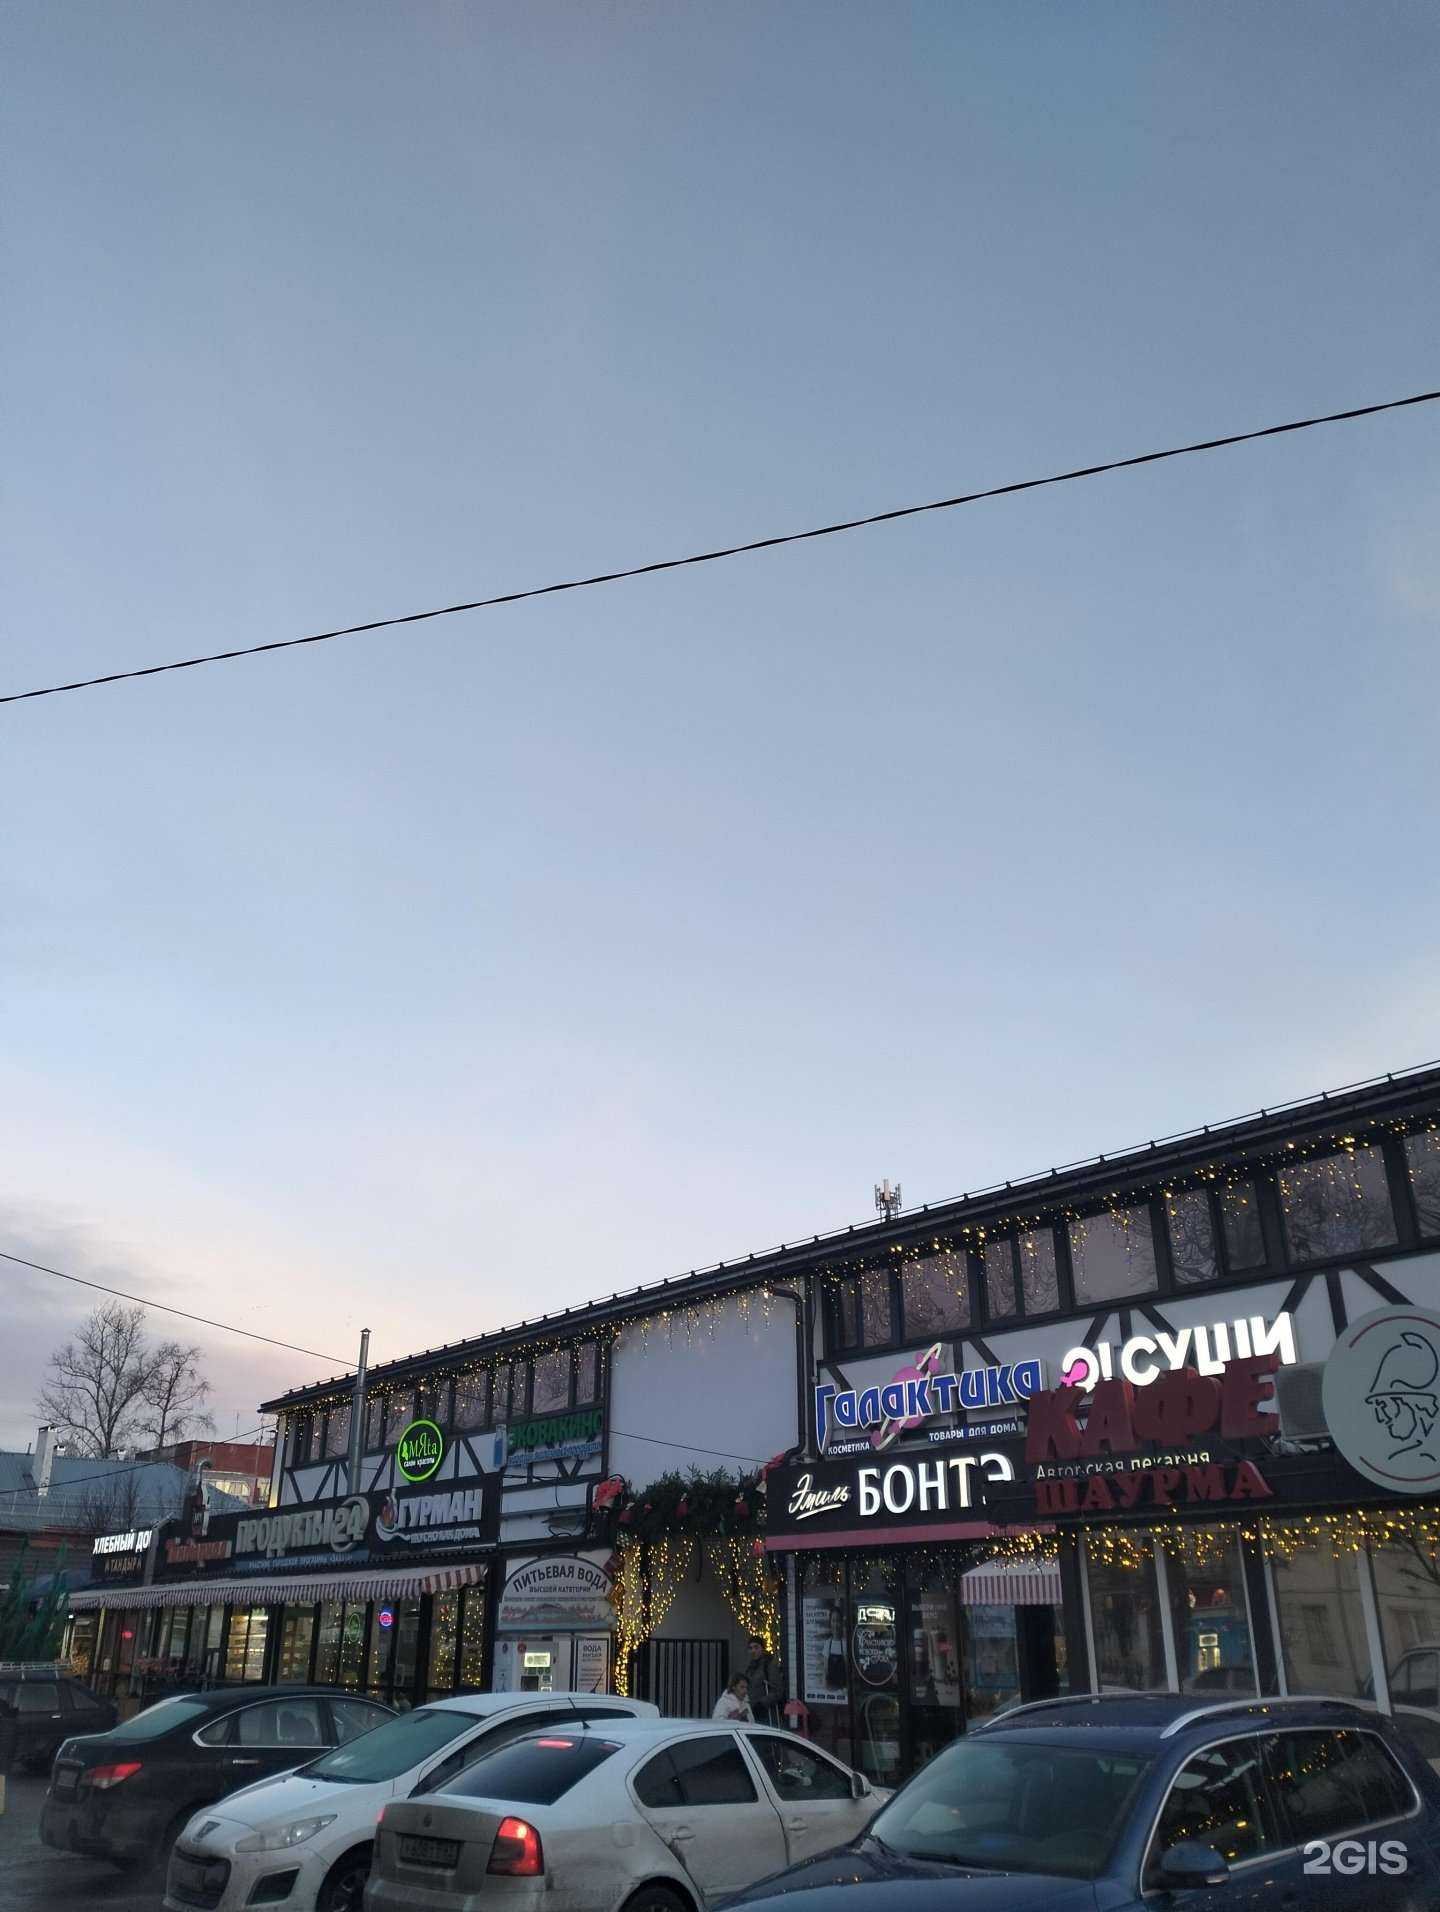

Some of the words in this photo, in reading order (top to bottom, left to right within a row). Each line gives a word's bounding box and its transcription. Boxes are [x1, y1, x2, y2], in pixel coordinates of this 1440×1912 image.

[815, 1359, 1042, 1455] Галактика
[1026, 1355, 1281, 1463] КАФЕ
[828, 1441, 871, 1456] КОСМЕТИКА
[929, 1430, 964, 1442] ТОВАРЫ
[968, 1427, 987, 1438] ДЛЯ
[990, 1422, 1017, 1436] ДОМА
[788, 1473, 852, 1516] Эмиль
[1033, 1460, 1275, 1515] ШАУРМА
[397, 1489, 483, 1530] ГУРМАН
[92, 1529, 135, 1554] ХЛЕБНЫЙ
[135, 1530, 153, 1553] ДО
[236, 1508, 334, 1558] ПРОДУКТЫ
[513, 1565, 575, 1593] ПИТЬЕВАЯ
[577, 1567, 608, 1593] ВОДА
[558, 1585, 591, 1593] КАТЕГОРИИ
